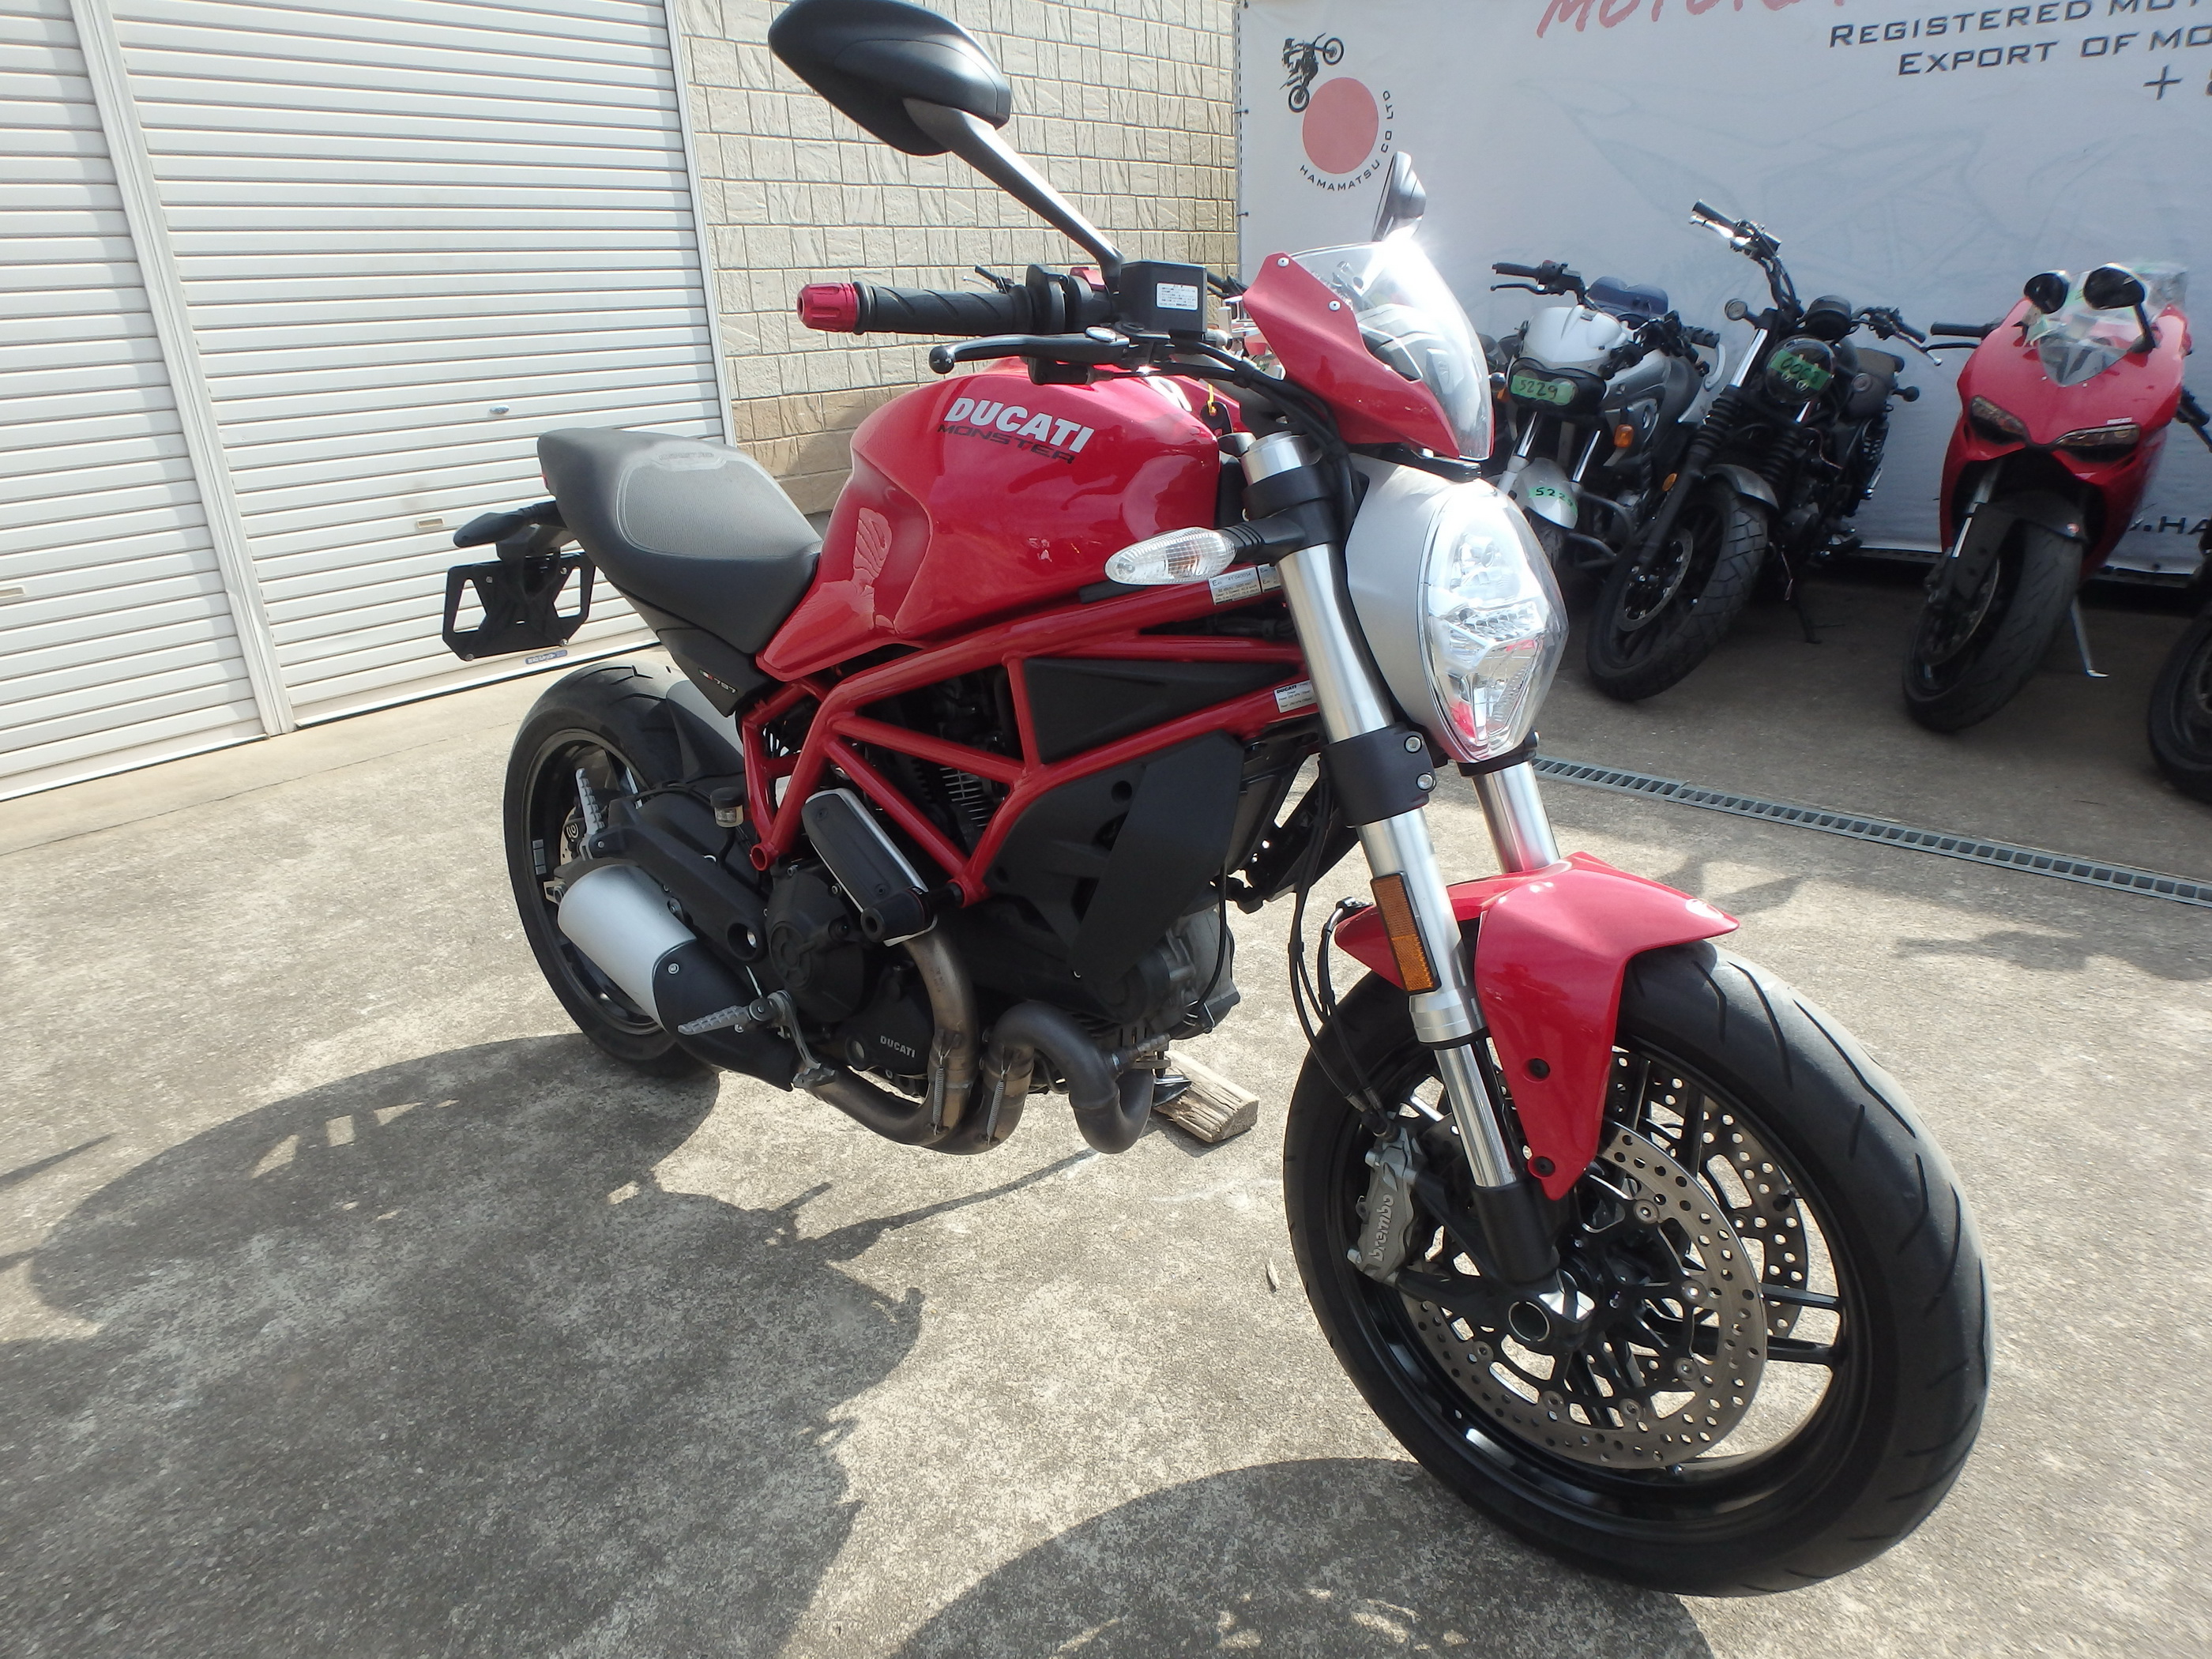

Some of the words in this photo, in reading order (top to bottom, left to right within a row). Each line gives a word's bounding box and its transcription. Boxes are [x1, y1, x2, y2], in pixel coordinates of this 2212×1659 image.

[1830, 0, 2092, 48] REGISTERED
[1898, 40, 2060, 76] EXPORT
[2080, 32, 2139, 58] OF
[1382, 90, 1394, 119] LTD
[1380, 130, 1392, 153] CO
[1300, 159, 1380, 191] HAMAMATSU
[1519, 379, 1559, 401] 5229
[944, 397, 1095, 453] DUCATI
[937, 423, 1075, 465] MONSTER
[713, 677, 736, 694] 797
[1277, 685, 1297, 694] DUCATI
[880, 1035, 916, 1059] DUCATI
[1368, 1194, 1394, 1262] brembo
